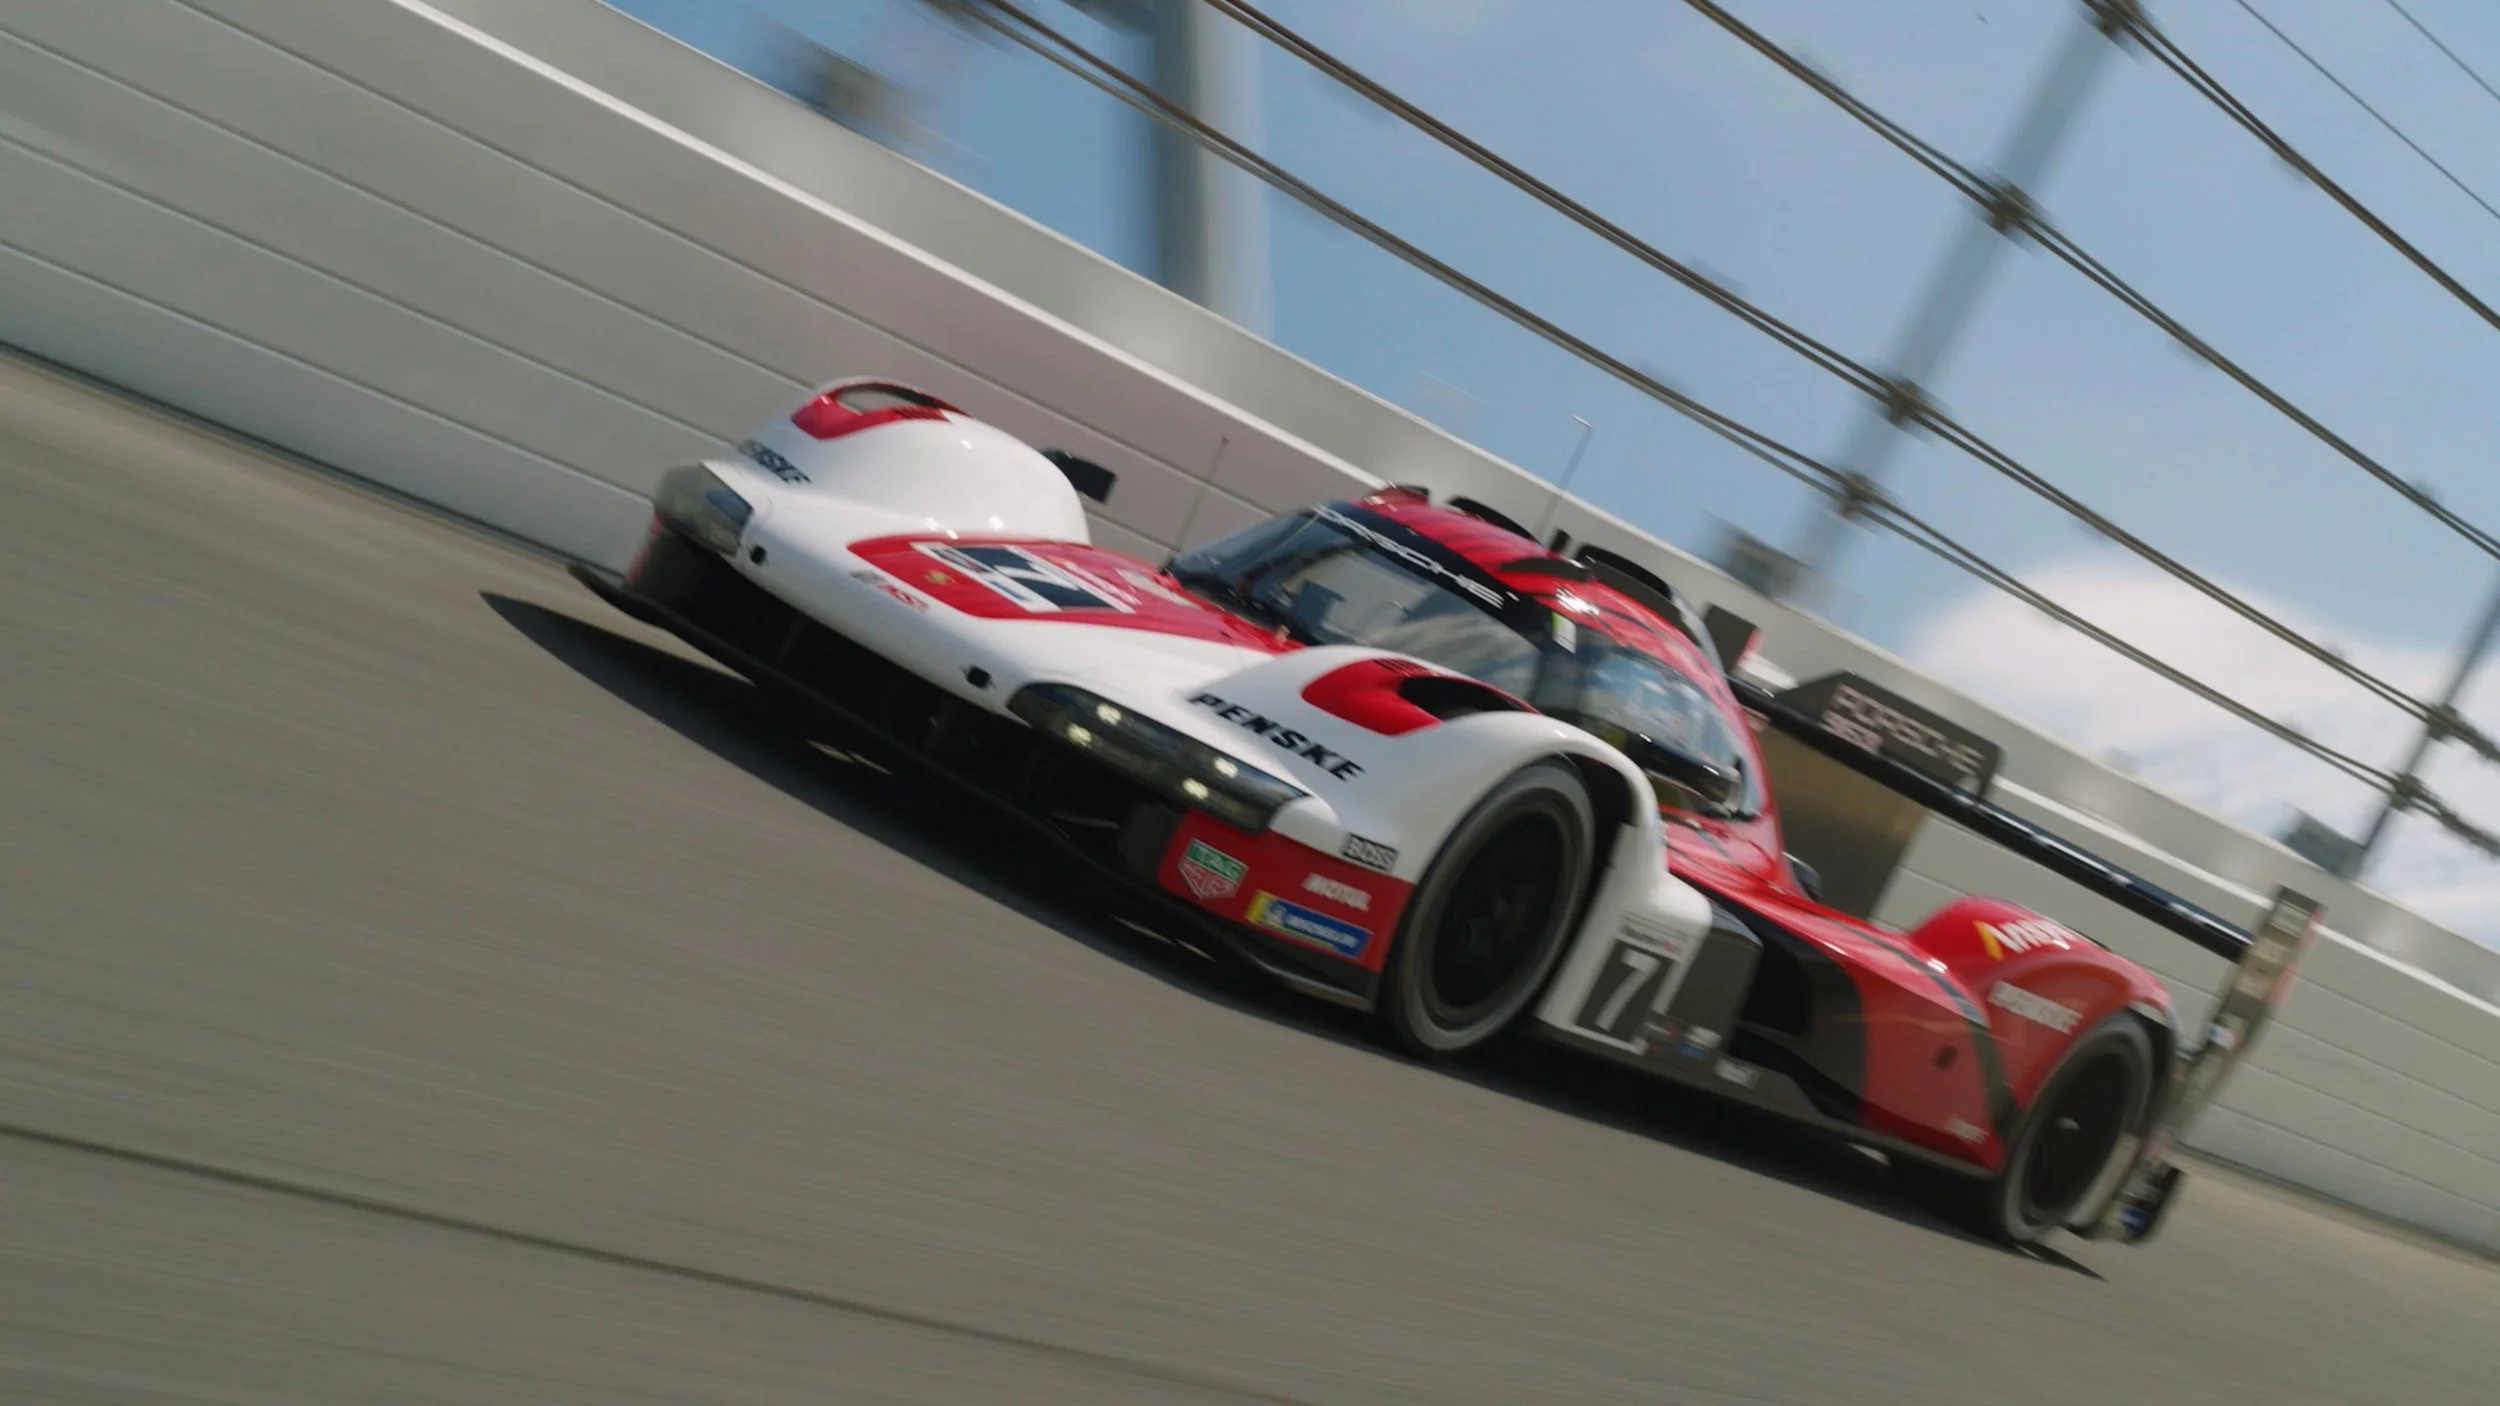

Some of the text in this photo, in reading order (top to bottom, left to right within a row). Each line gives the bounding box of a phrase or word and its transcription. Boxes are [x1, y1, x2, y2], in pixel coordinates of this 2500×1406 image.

[1188, 691, 1366, 782] PENSKE
[1831, 683, 1985, 776] PORSCHE
[1344, 835, 1396, 870] BOSS
[1595, 947, 1660, 1031] 7
